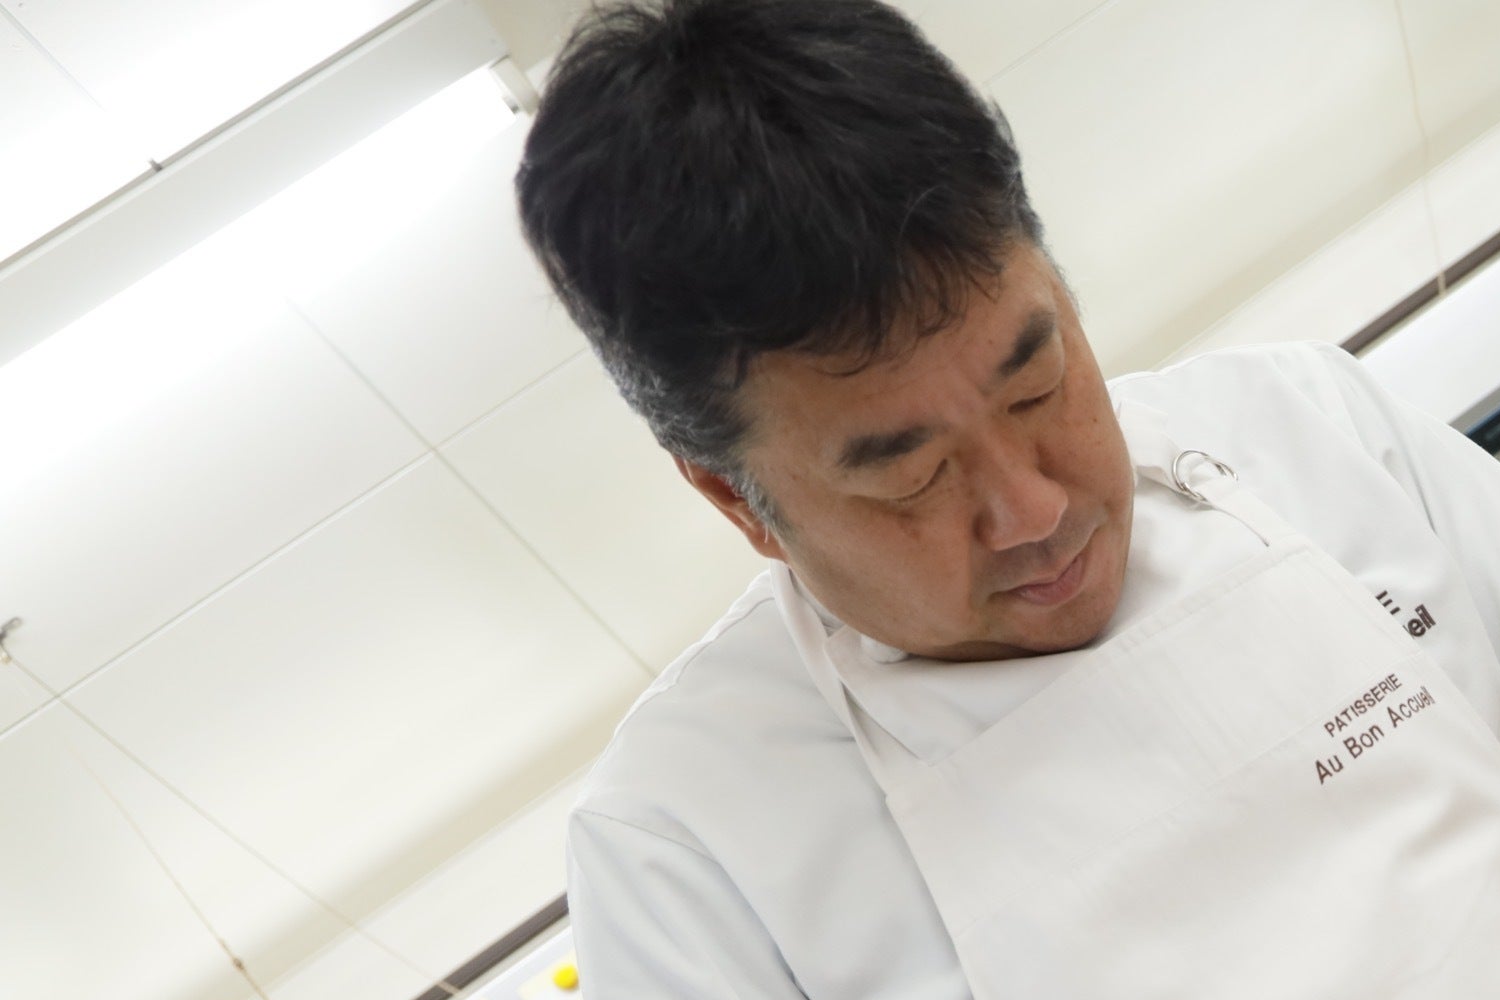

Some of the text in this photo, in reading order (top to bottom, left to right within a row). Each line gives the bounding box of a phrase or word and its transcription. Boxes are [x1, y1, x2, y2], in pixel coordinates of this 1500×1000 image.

[1323, 673, 1402, 737] PATISSERIE
[1315, 755, 1344, 785] Au
[1343, 725, 1384, 759] Bon
